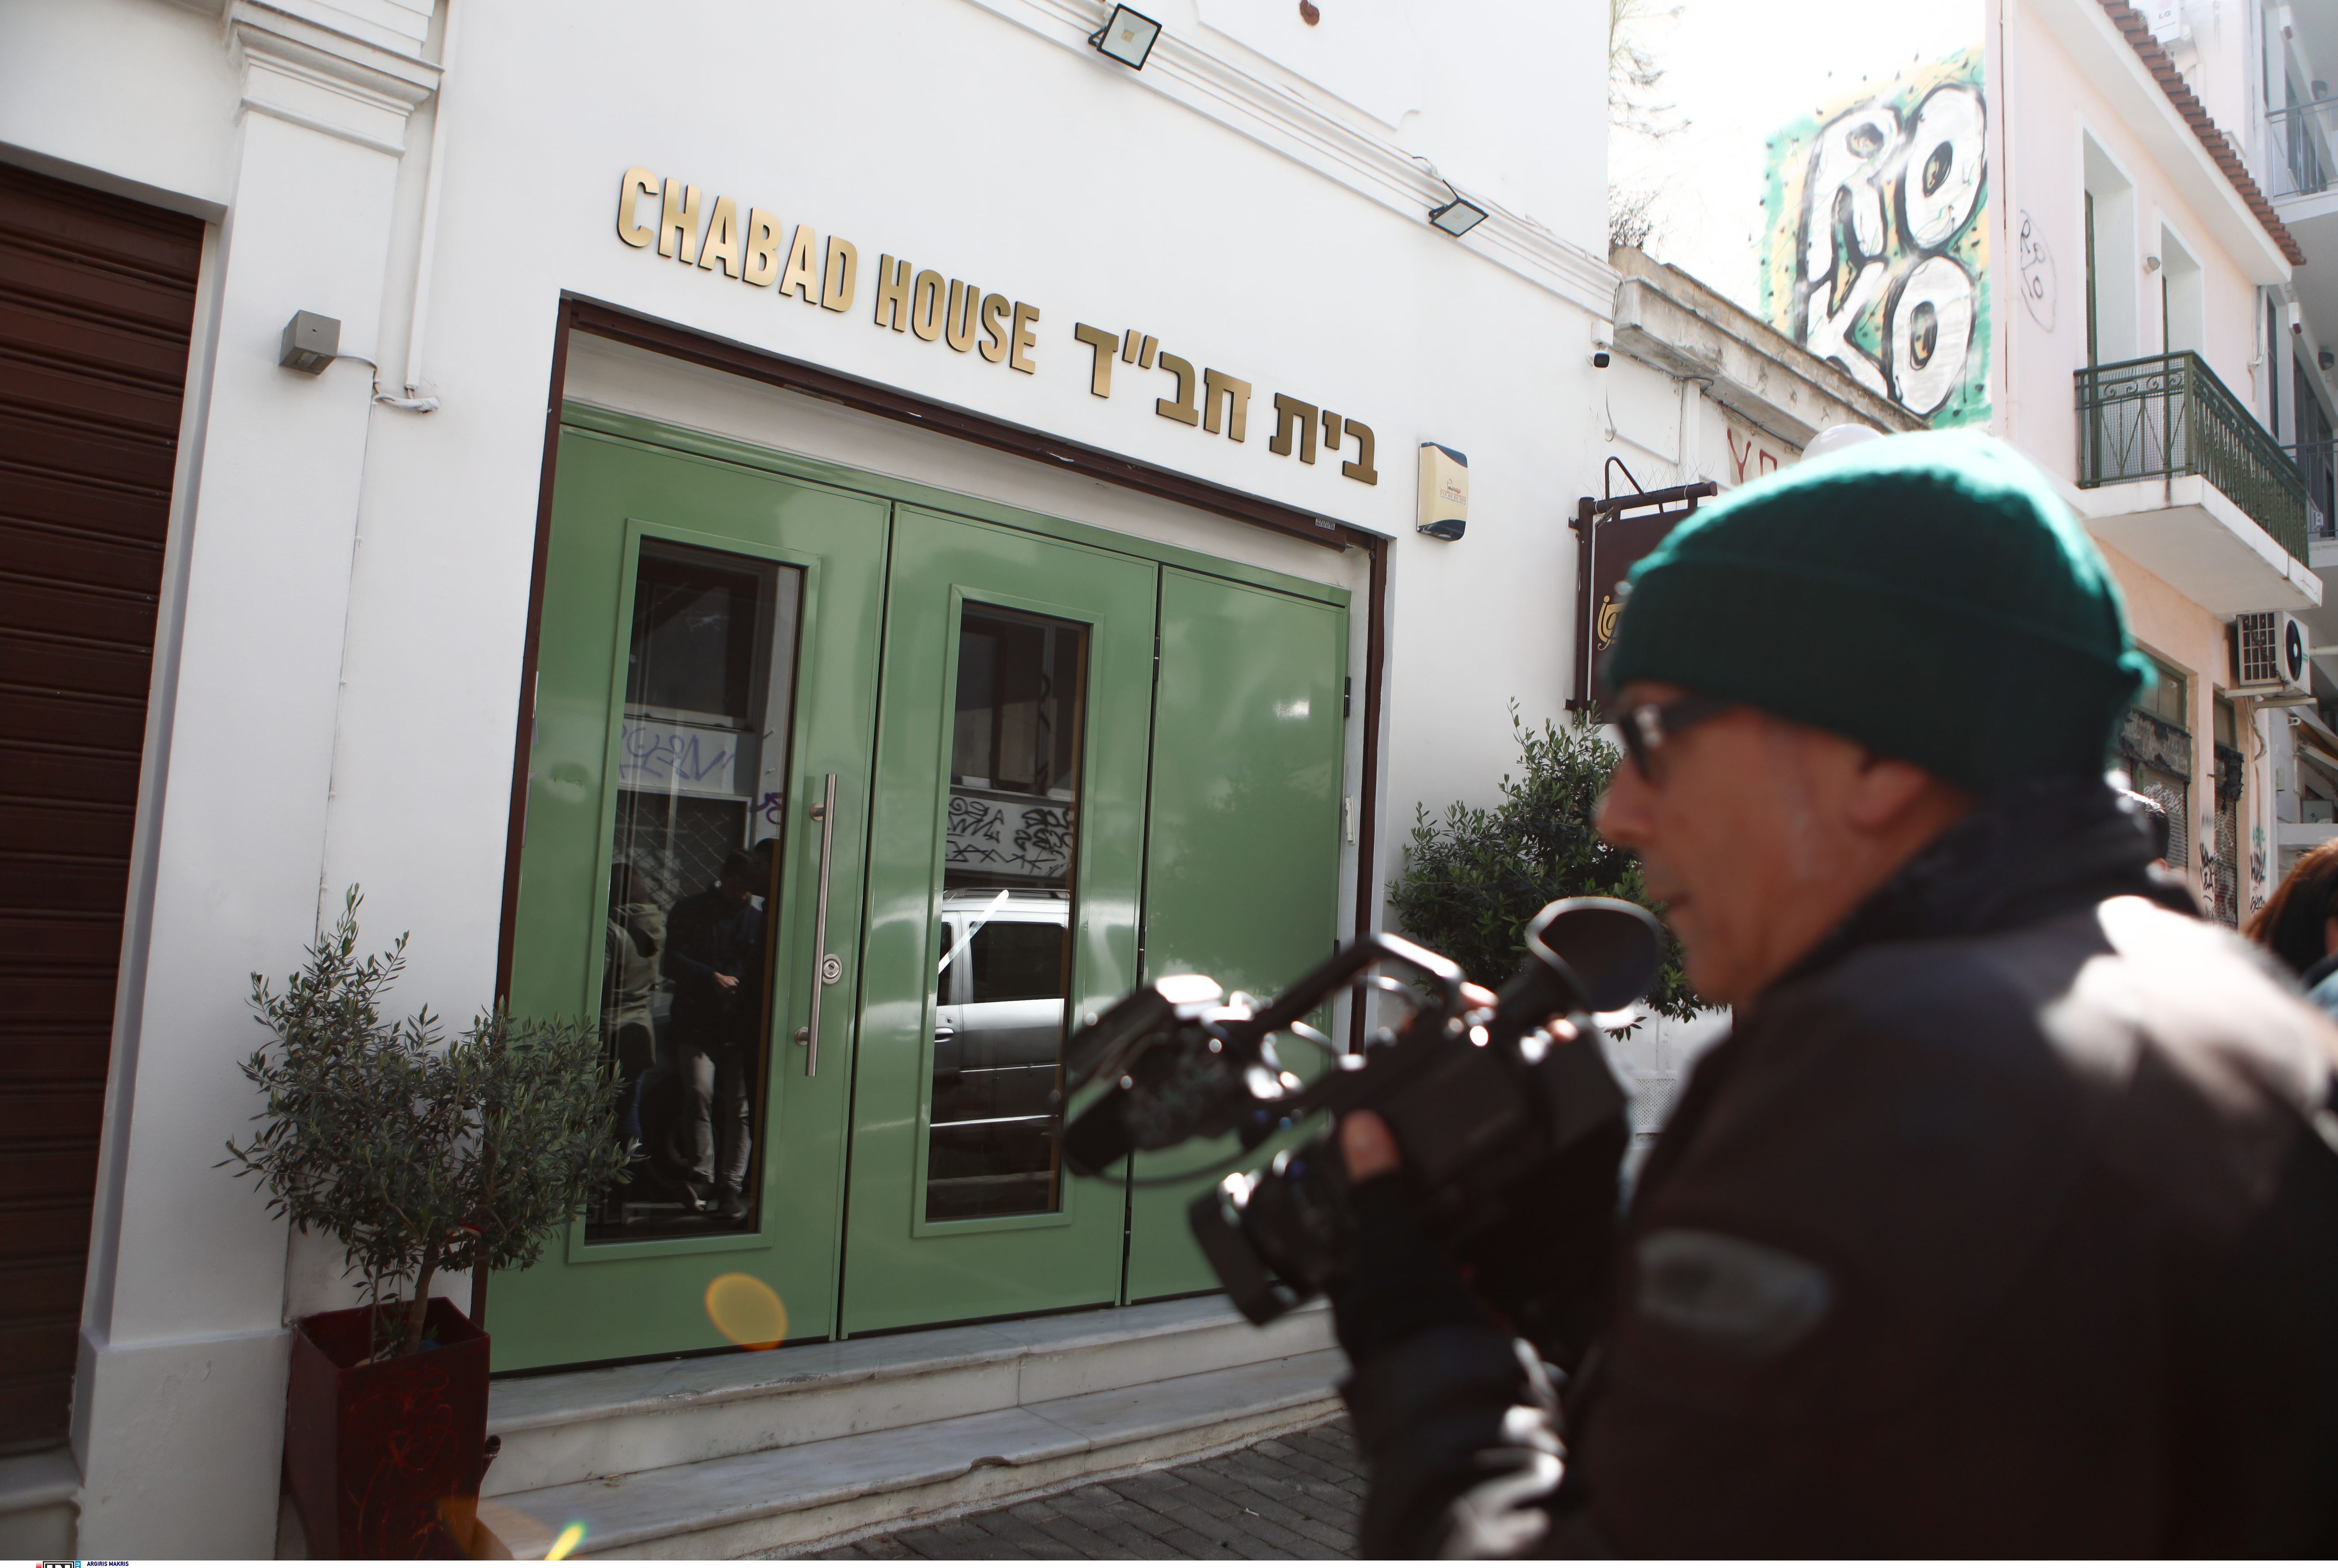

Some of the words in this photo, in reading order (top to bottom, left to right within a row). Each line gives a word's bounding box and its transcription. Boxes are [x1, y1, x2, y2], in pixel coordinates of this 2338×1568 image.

[2158, 11, 2171, 19] LG
[617, 167, 858, 312] CHABAD
[874, 253, 1040, 375] HOUSE
[1269, 392, 1378, 485] בית
